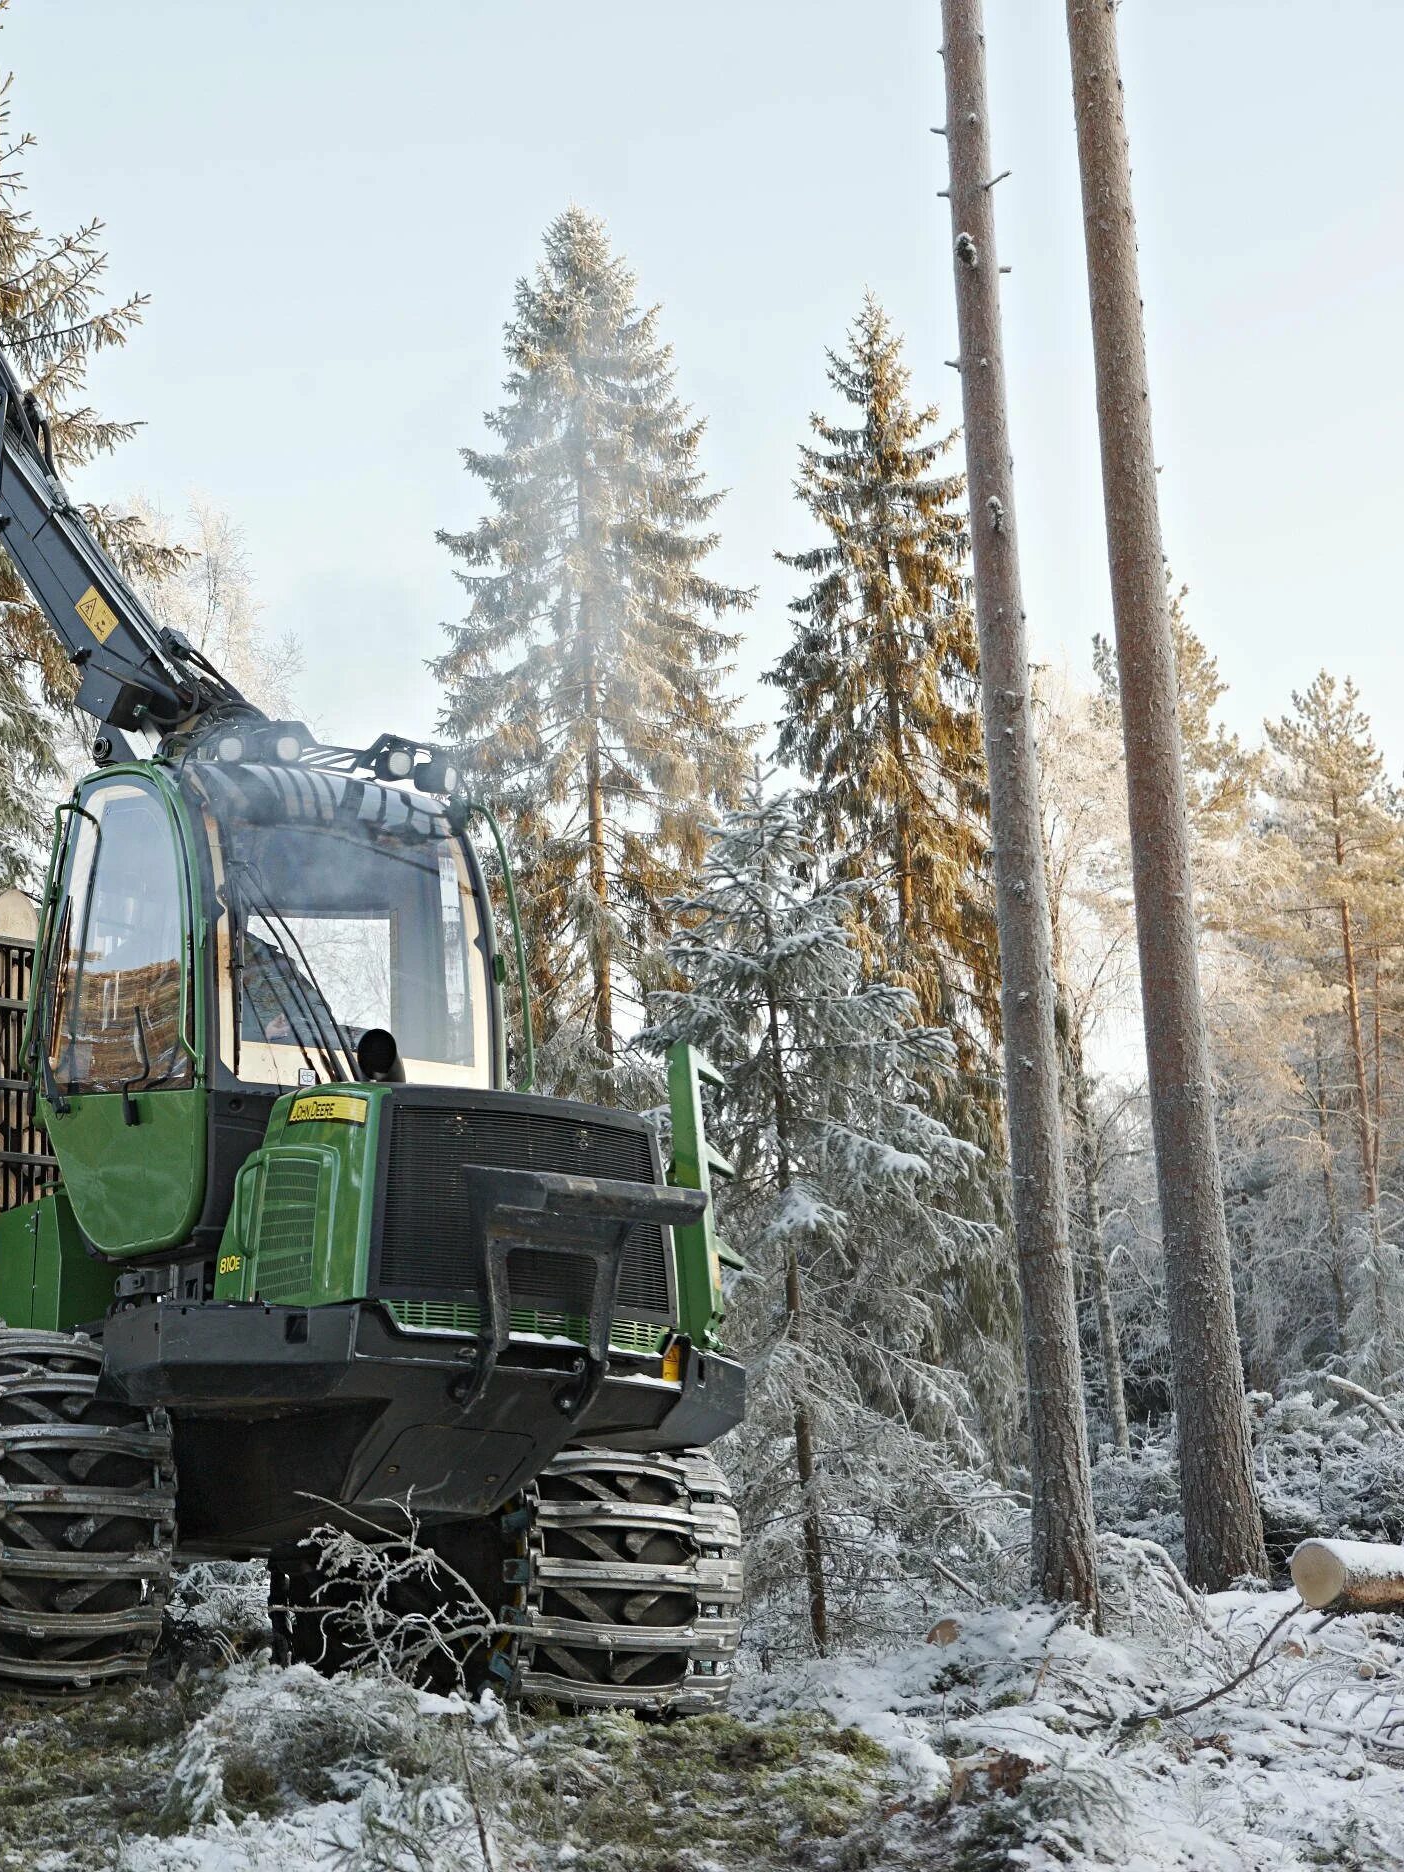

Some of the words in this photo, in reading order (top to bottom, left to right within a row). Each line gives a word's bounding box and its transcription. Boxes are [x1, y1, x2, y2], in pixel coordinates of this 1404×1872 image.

[292, 1103, 311, 1119] JOHN
[310, 1101, 335, 1117] DEERE
[219, 1255, 241, 1274] 810E
